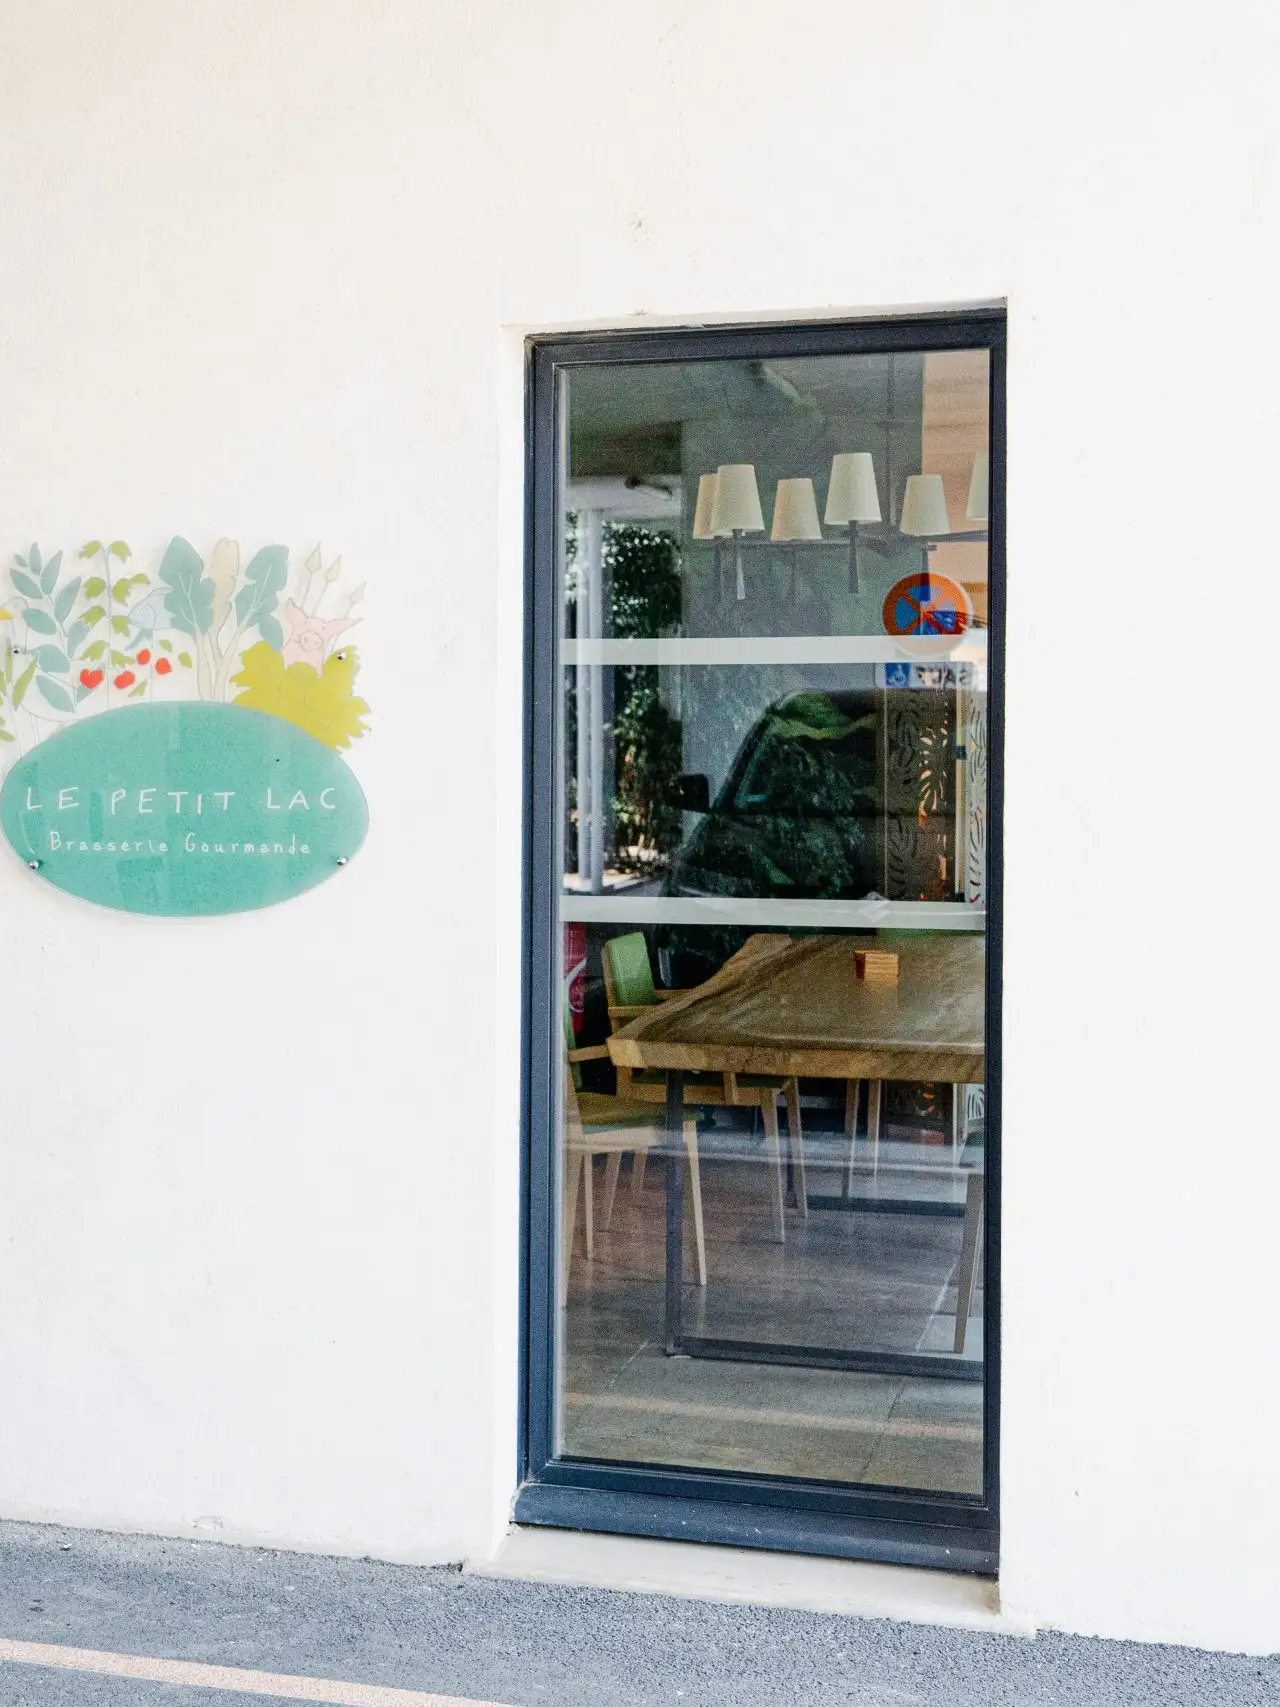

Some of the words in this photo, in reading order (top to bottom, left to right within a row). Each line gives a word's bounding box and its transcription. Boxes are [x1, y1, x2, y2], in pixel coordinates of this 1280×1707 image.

[25, 786, 80, 810] LE
[110, 787, 236, 815] PETIT
[266, 787, 337, 810] LAC
[48, 831, 169, 852] Brasserie
[184, 833, 312, 854] Gourmande
